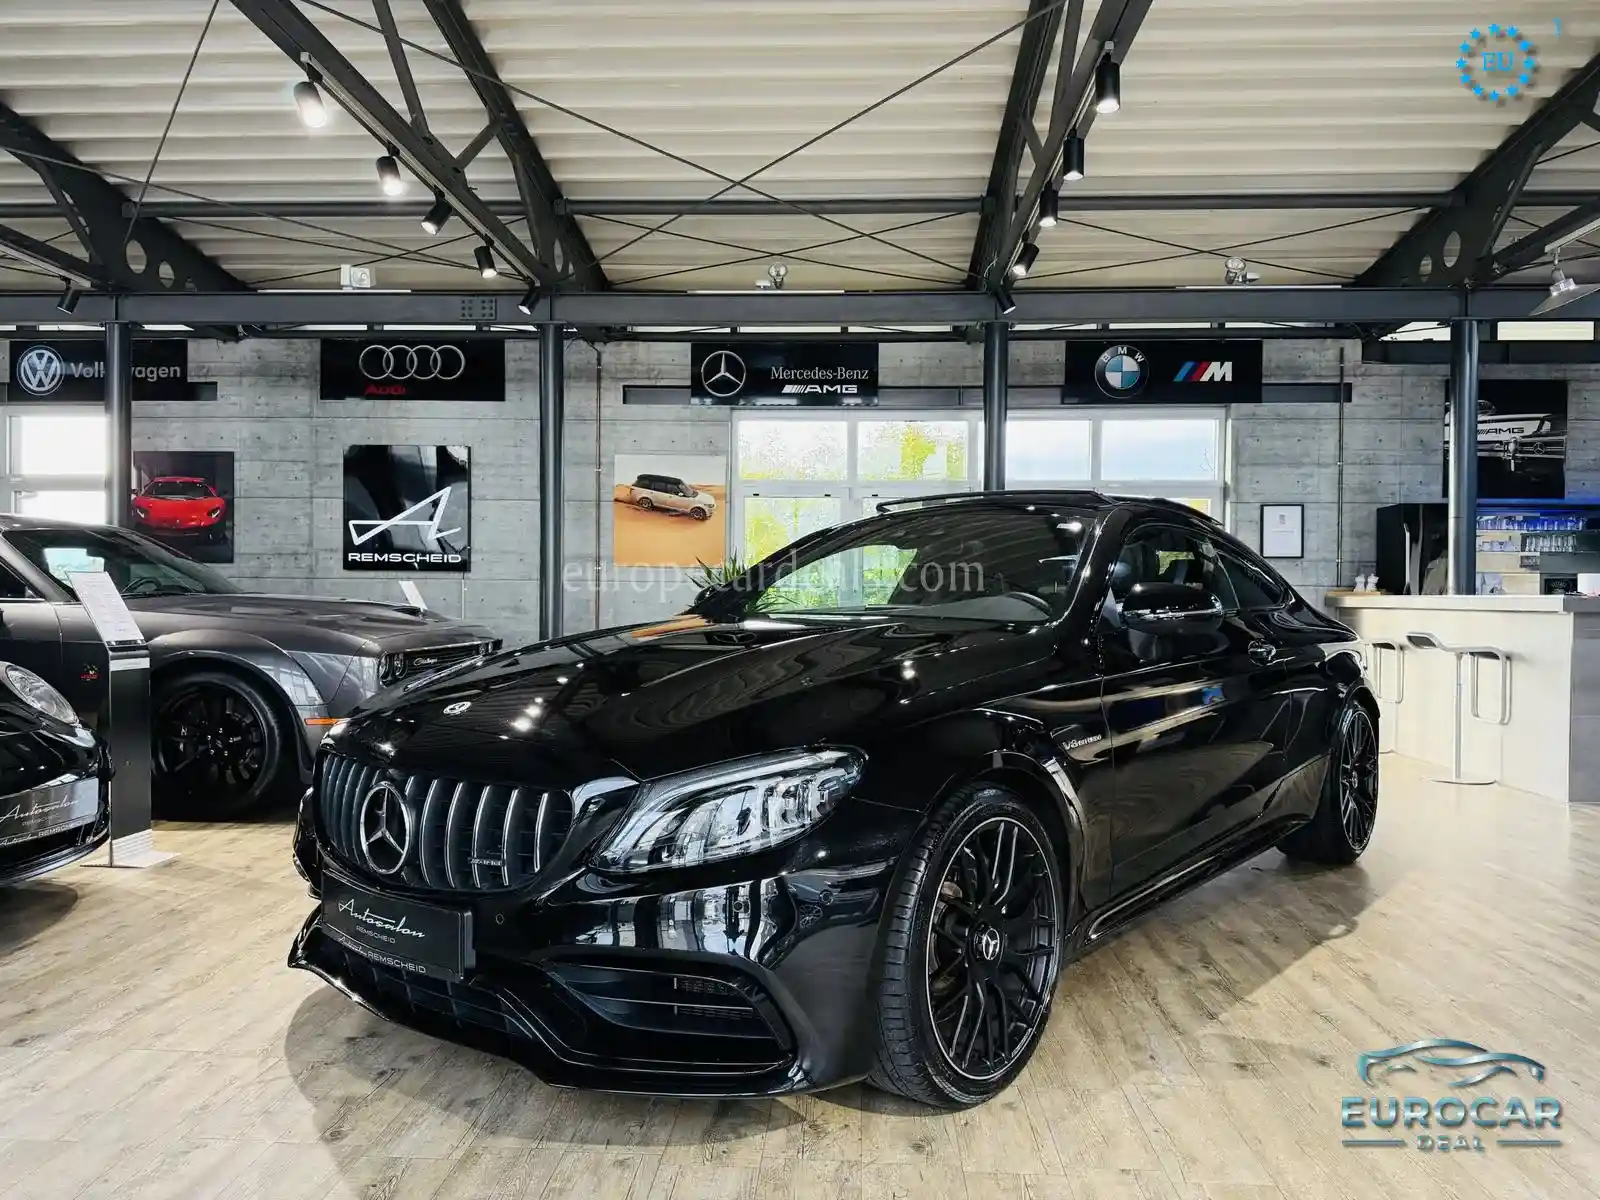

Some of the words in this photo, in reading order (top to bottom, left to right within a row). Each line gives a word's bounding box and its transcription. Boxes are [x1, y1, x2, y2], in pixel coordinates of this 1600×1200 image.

[71, 361, 181, 382] Volagen
[770, 366, 869, 380] Mercedes-Benz
[804, 384, 858, 394] AMG
[1486, 427, 1525, 435] AMG
[347, 552, 462, 564] REMSCHEID
[338, 898, 426, 938] Autosalon
[355, 925, 396, 944] REMSCHEID
[367, 950, 427, 974] REMSCHEID
